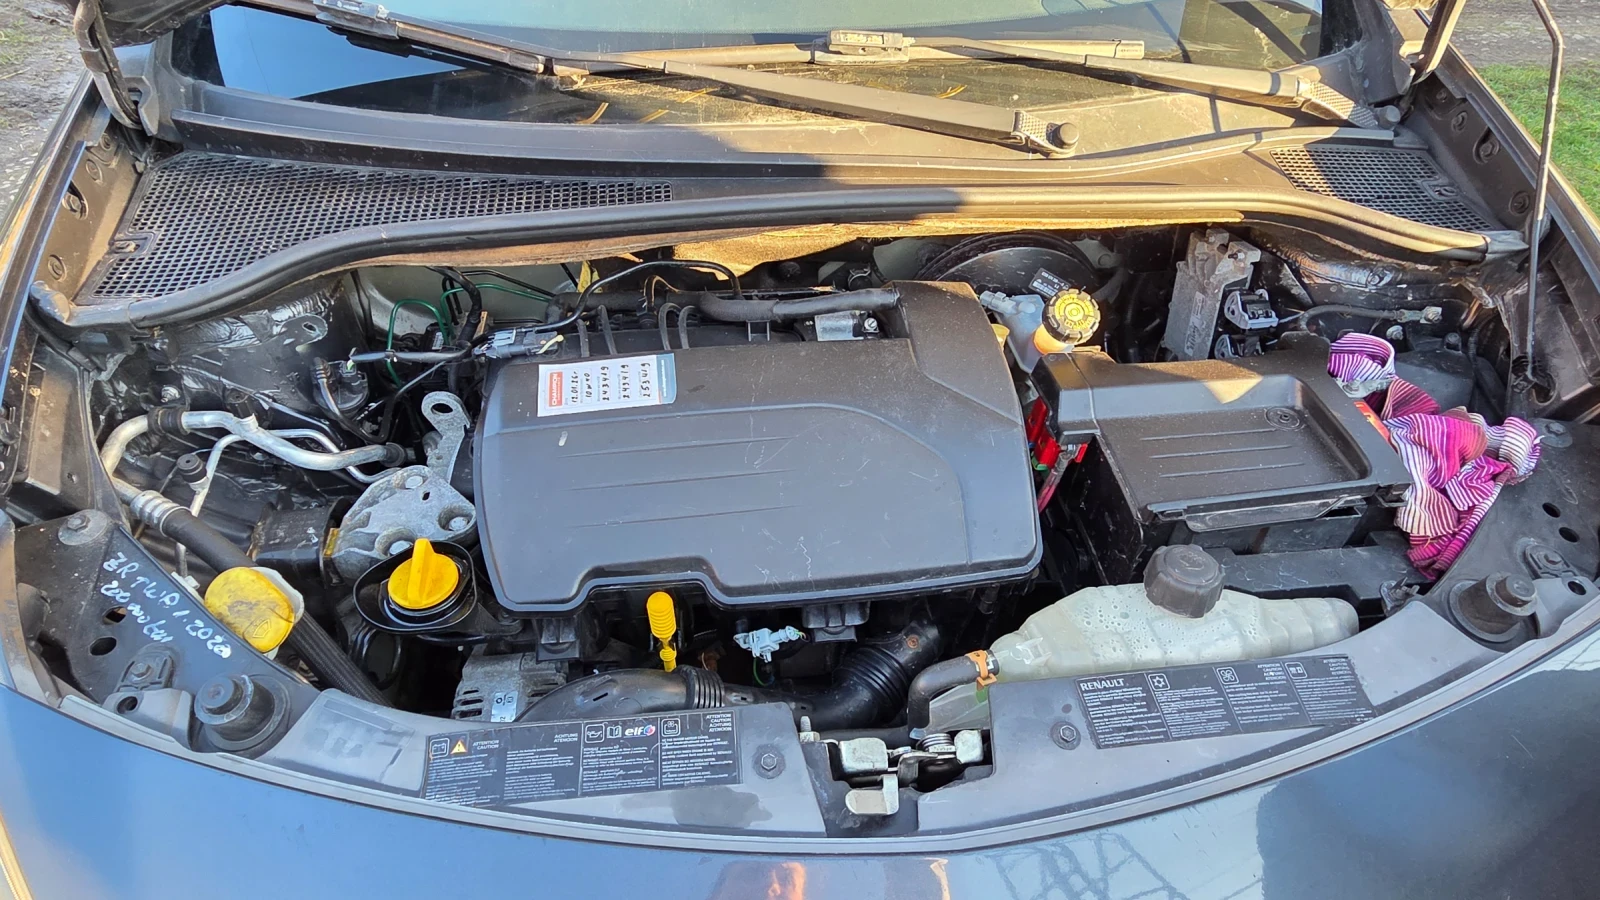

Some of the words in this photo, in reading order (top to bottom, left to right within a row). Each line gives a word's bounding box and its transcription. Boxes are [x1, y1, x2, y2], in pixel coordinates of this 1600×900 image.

[551, 373, 559, 406] CHAMPION
[1080, 678, 1124, 691] RENAULT
[624, 727, 644, 736] elf
[472, 739, 500, 747] ATTENTION
